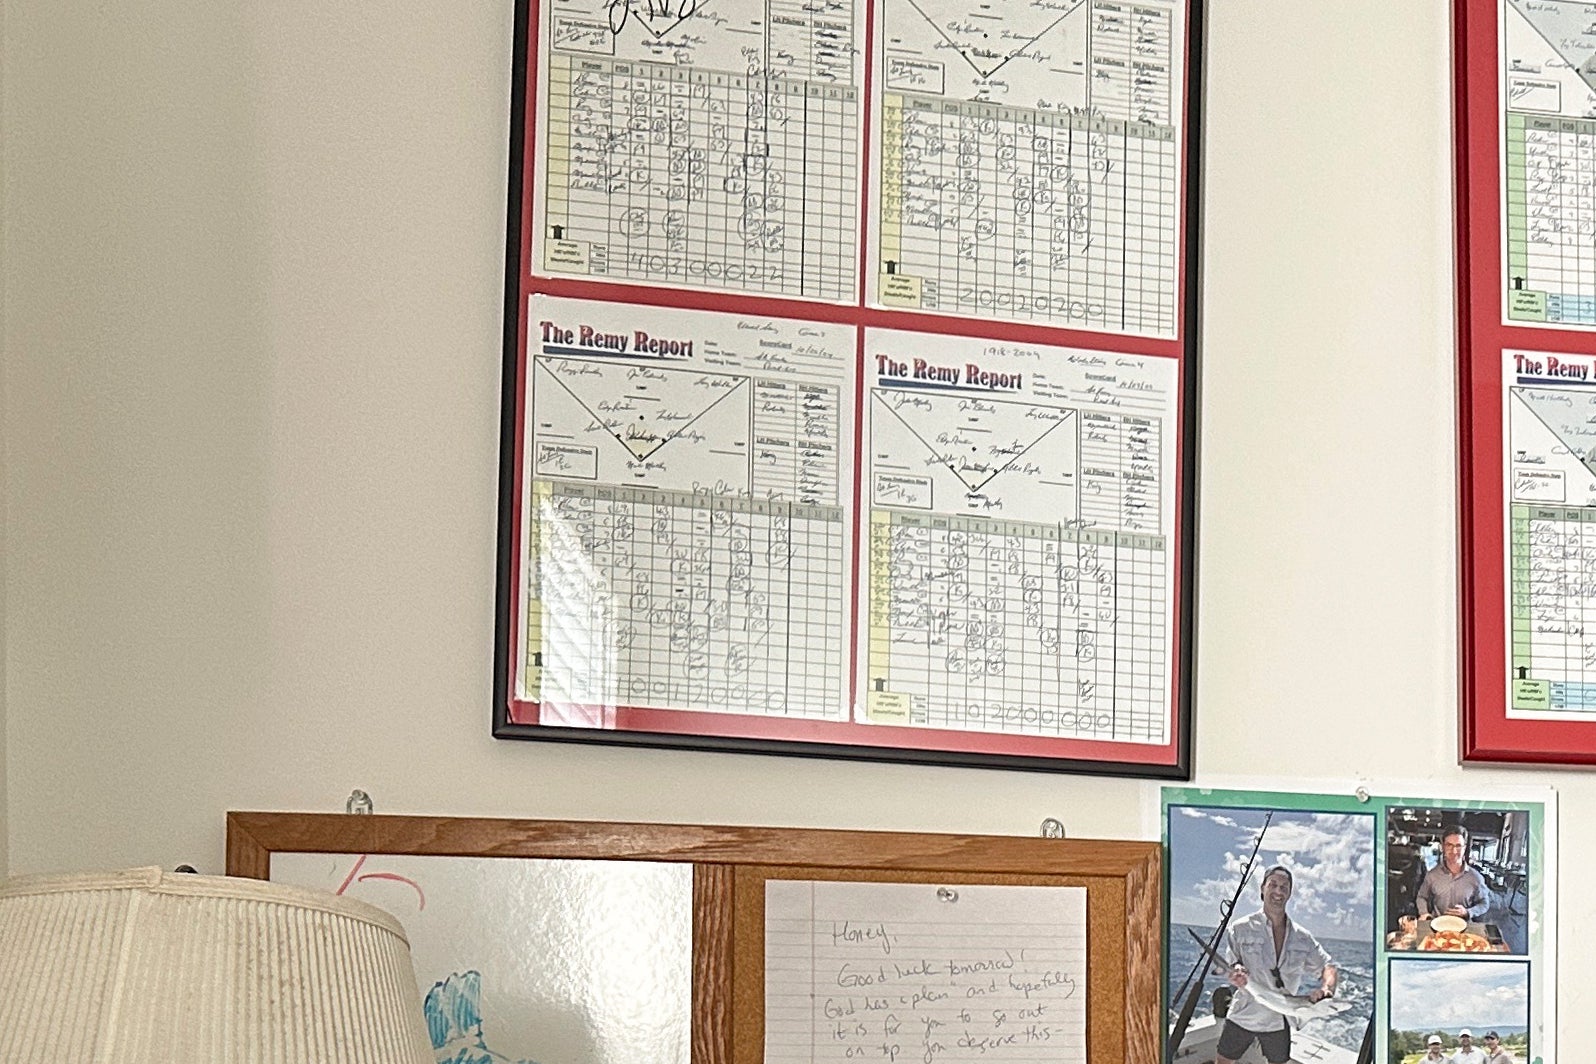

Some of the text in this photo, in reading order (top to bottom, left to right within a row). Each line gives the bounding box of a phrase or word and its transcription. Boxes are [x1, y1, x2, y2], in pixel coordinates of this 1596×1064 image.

[540, 321, 693, 358] The Remy Report
[875, 354, 1023, 390] The Remy Report
[1514, 354, 1543, 375] The
[1546, 356, 1589, 379] Remy
[837, 963, 887, 988] Good
[894, 960, 941, 979] luck
[824, 998, 855, 1019] God
[864, 996, 889, 1011] has
[966, 978, 999, 998] and
[1008, 971, 1076, 999] hopefully
[830, 1021, 847, 1040] it
[854, 1018, 868, 1037] is
[884, 1014, 902, 1038] for
[921, 1015, 947, 1039] you
[957, 1008, 971, 1024] to
[1018, 1003, 1048, 1020] out
[846, 1045, 865, 1059] on
[923, 1038, 948, 1064] you
[957, 1030, 1017, 1054] deserve
